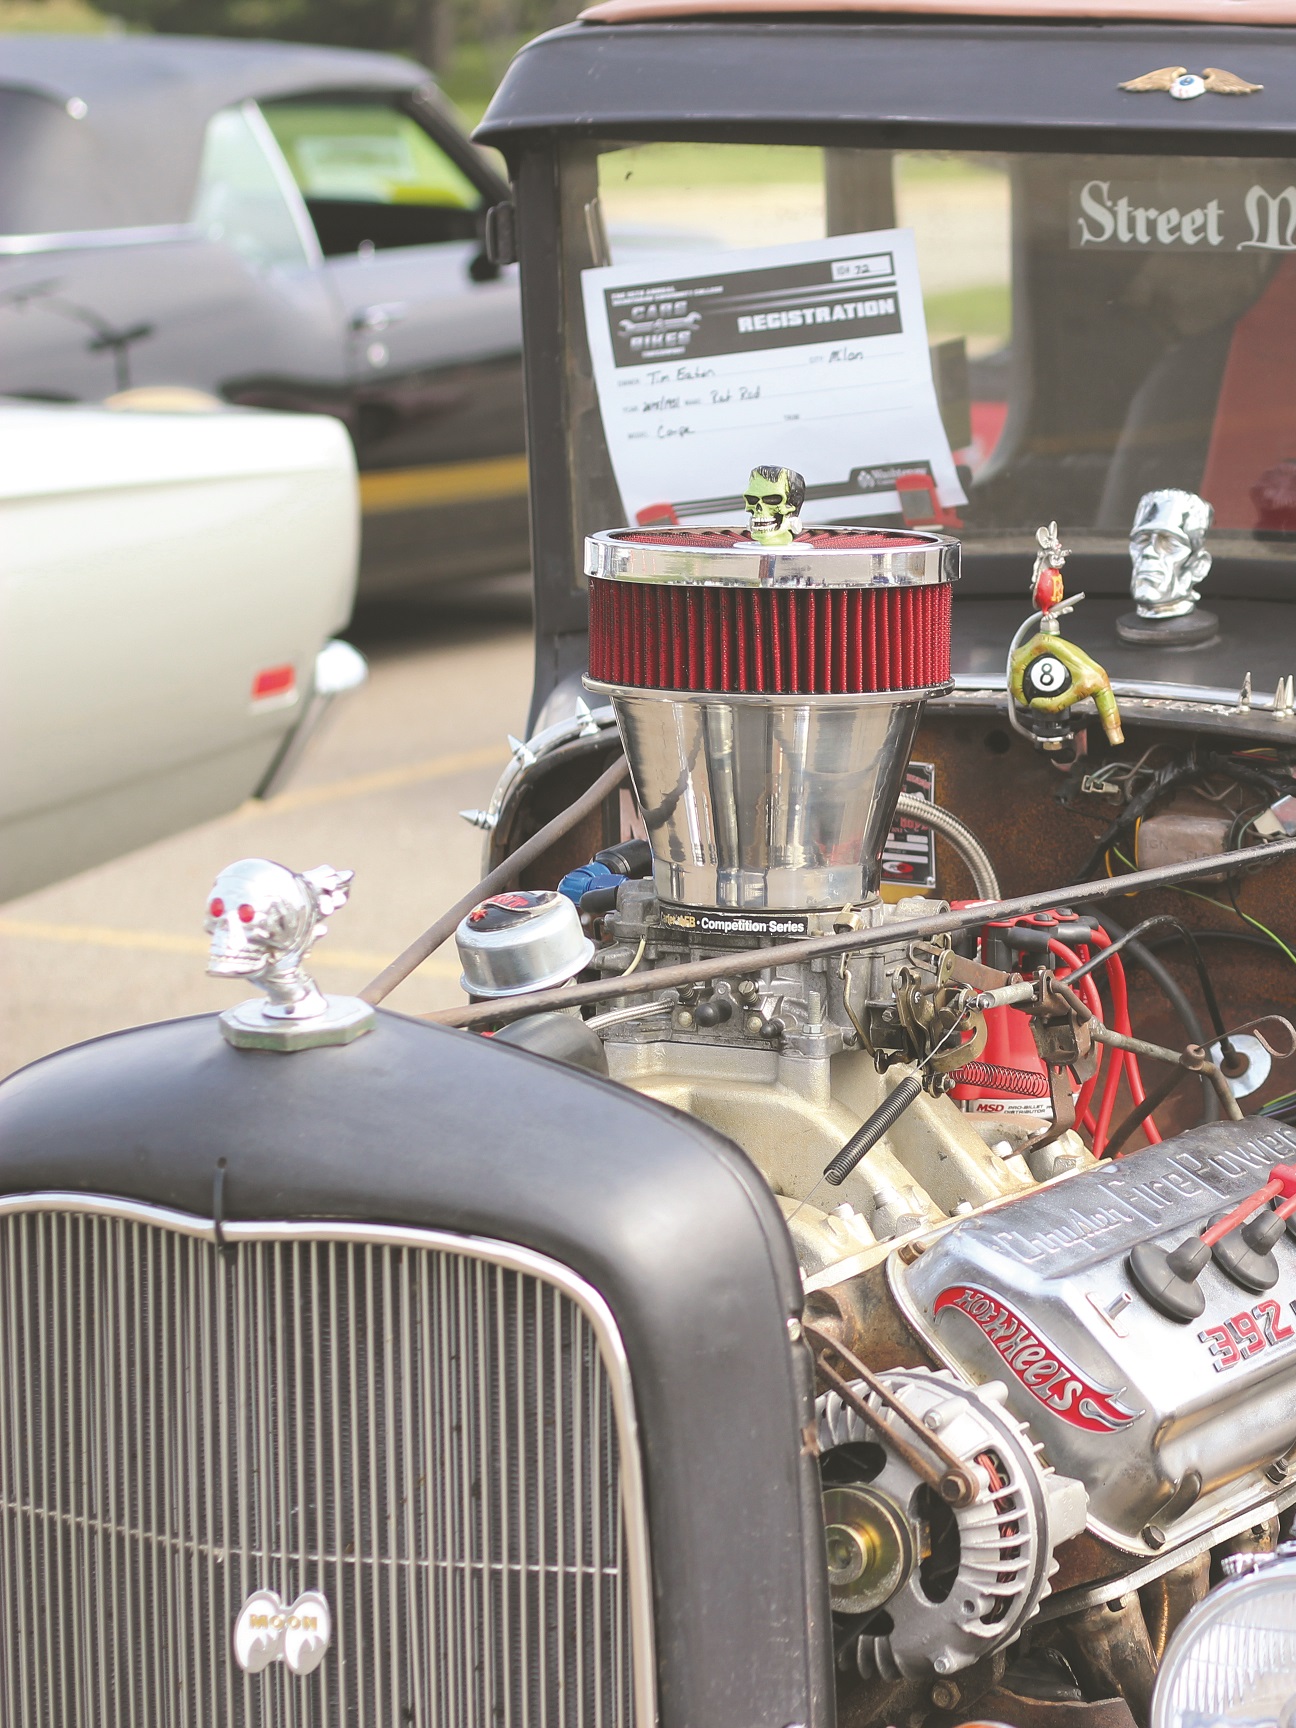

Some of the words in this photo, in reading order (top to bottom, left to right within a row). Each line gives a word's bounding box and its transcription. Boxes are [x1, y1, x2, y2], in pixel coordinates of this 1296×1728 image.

[1078, 180, 1224, 246] Street
[631, 300, 688, 320] CARS
[736, 297, 896, 334] REGISTRATION
[629, 330, 692, 352] BIKES
[1040, 663, 1055, 687] 8
[701, 917, 767, 934] Competition
[768, 920, 805, 933] Series
[976, 1103, 1004, 1112] MSD
[1007, 1103, 1043, 1111] PRO-BILLET
[953, 1289, 998, 1322] HOT
[1197, 1298, 1296, 1374] 392
[249, 1613, 318, 1631] MOON
